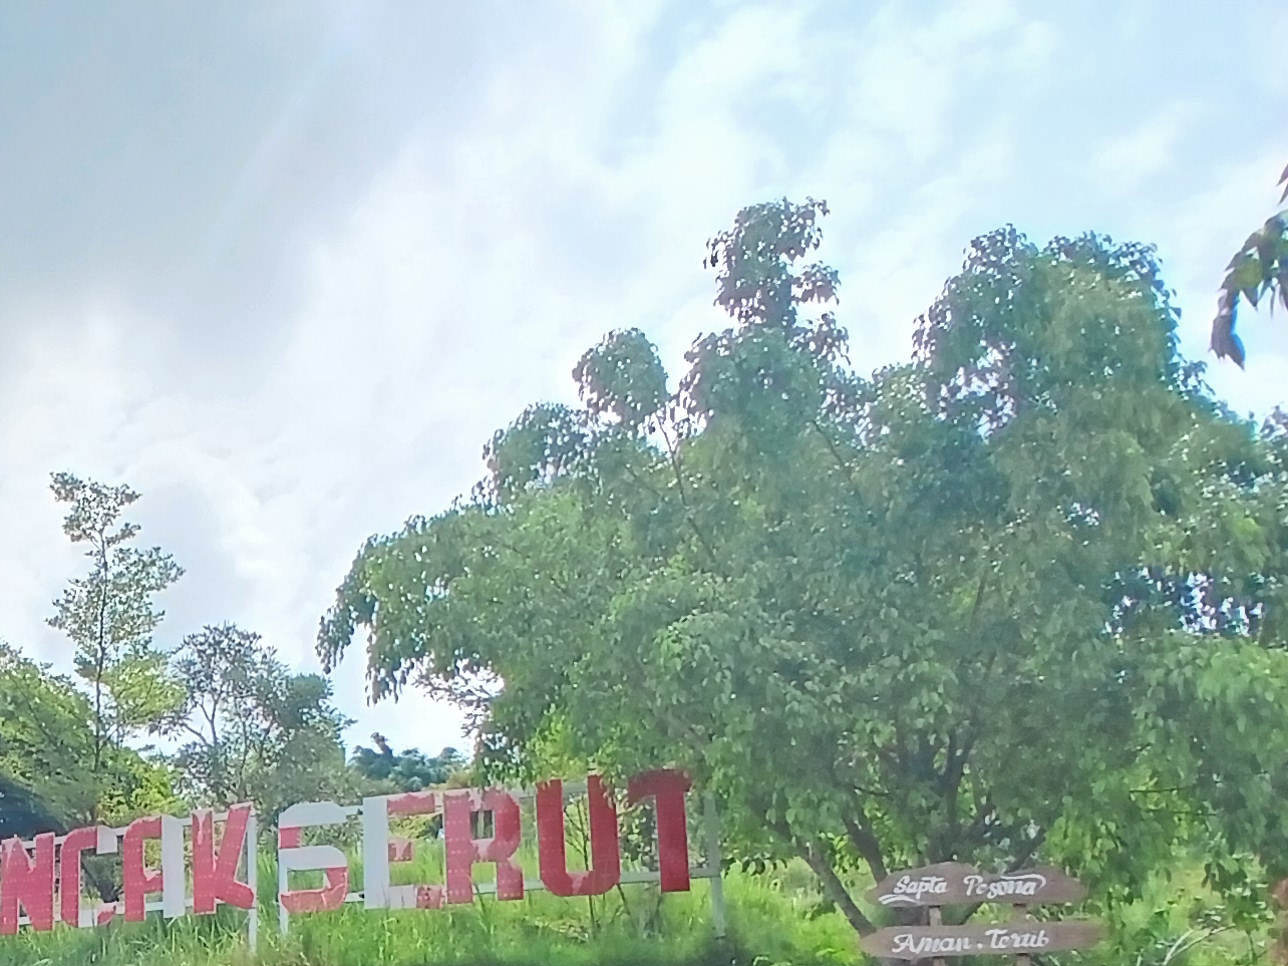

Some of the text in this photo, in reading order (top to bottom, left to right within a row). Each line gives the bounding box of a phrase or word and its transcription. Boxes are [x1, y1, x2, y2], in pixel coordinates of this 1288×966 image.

[278, 769, 691, 913] SERUT
[886, 873, 1047, 902] Sapta Pesona
[891, 928, 1050, 954] Aman Tertib
